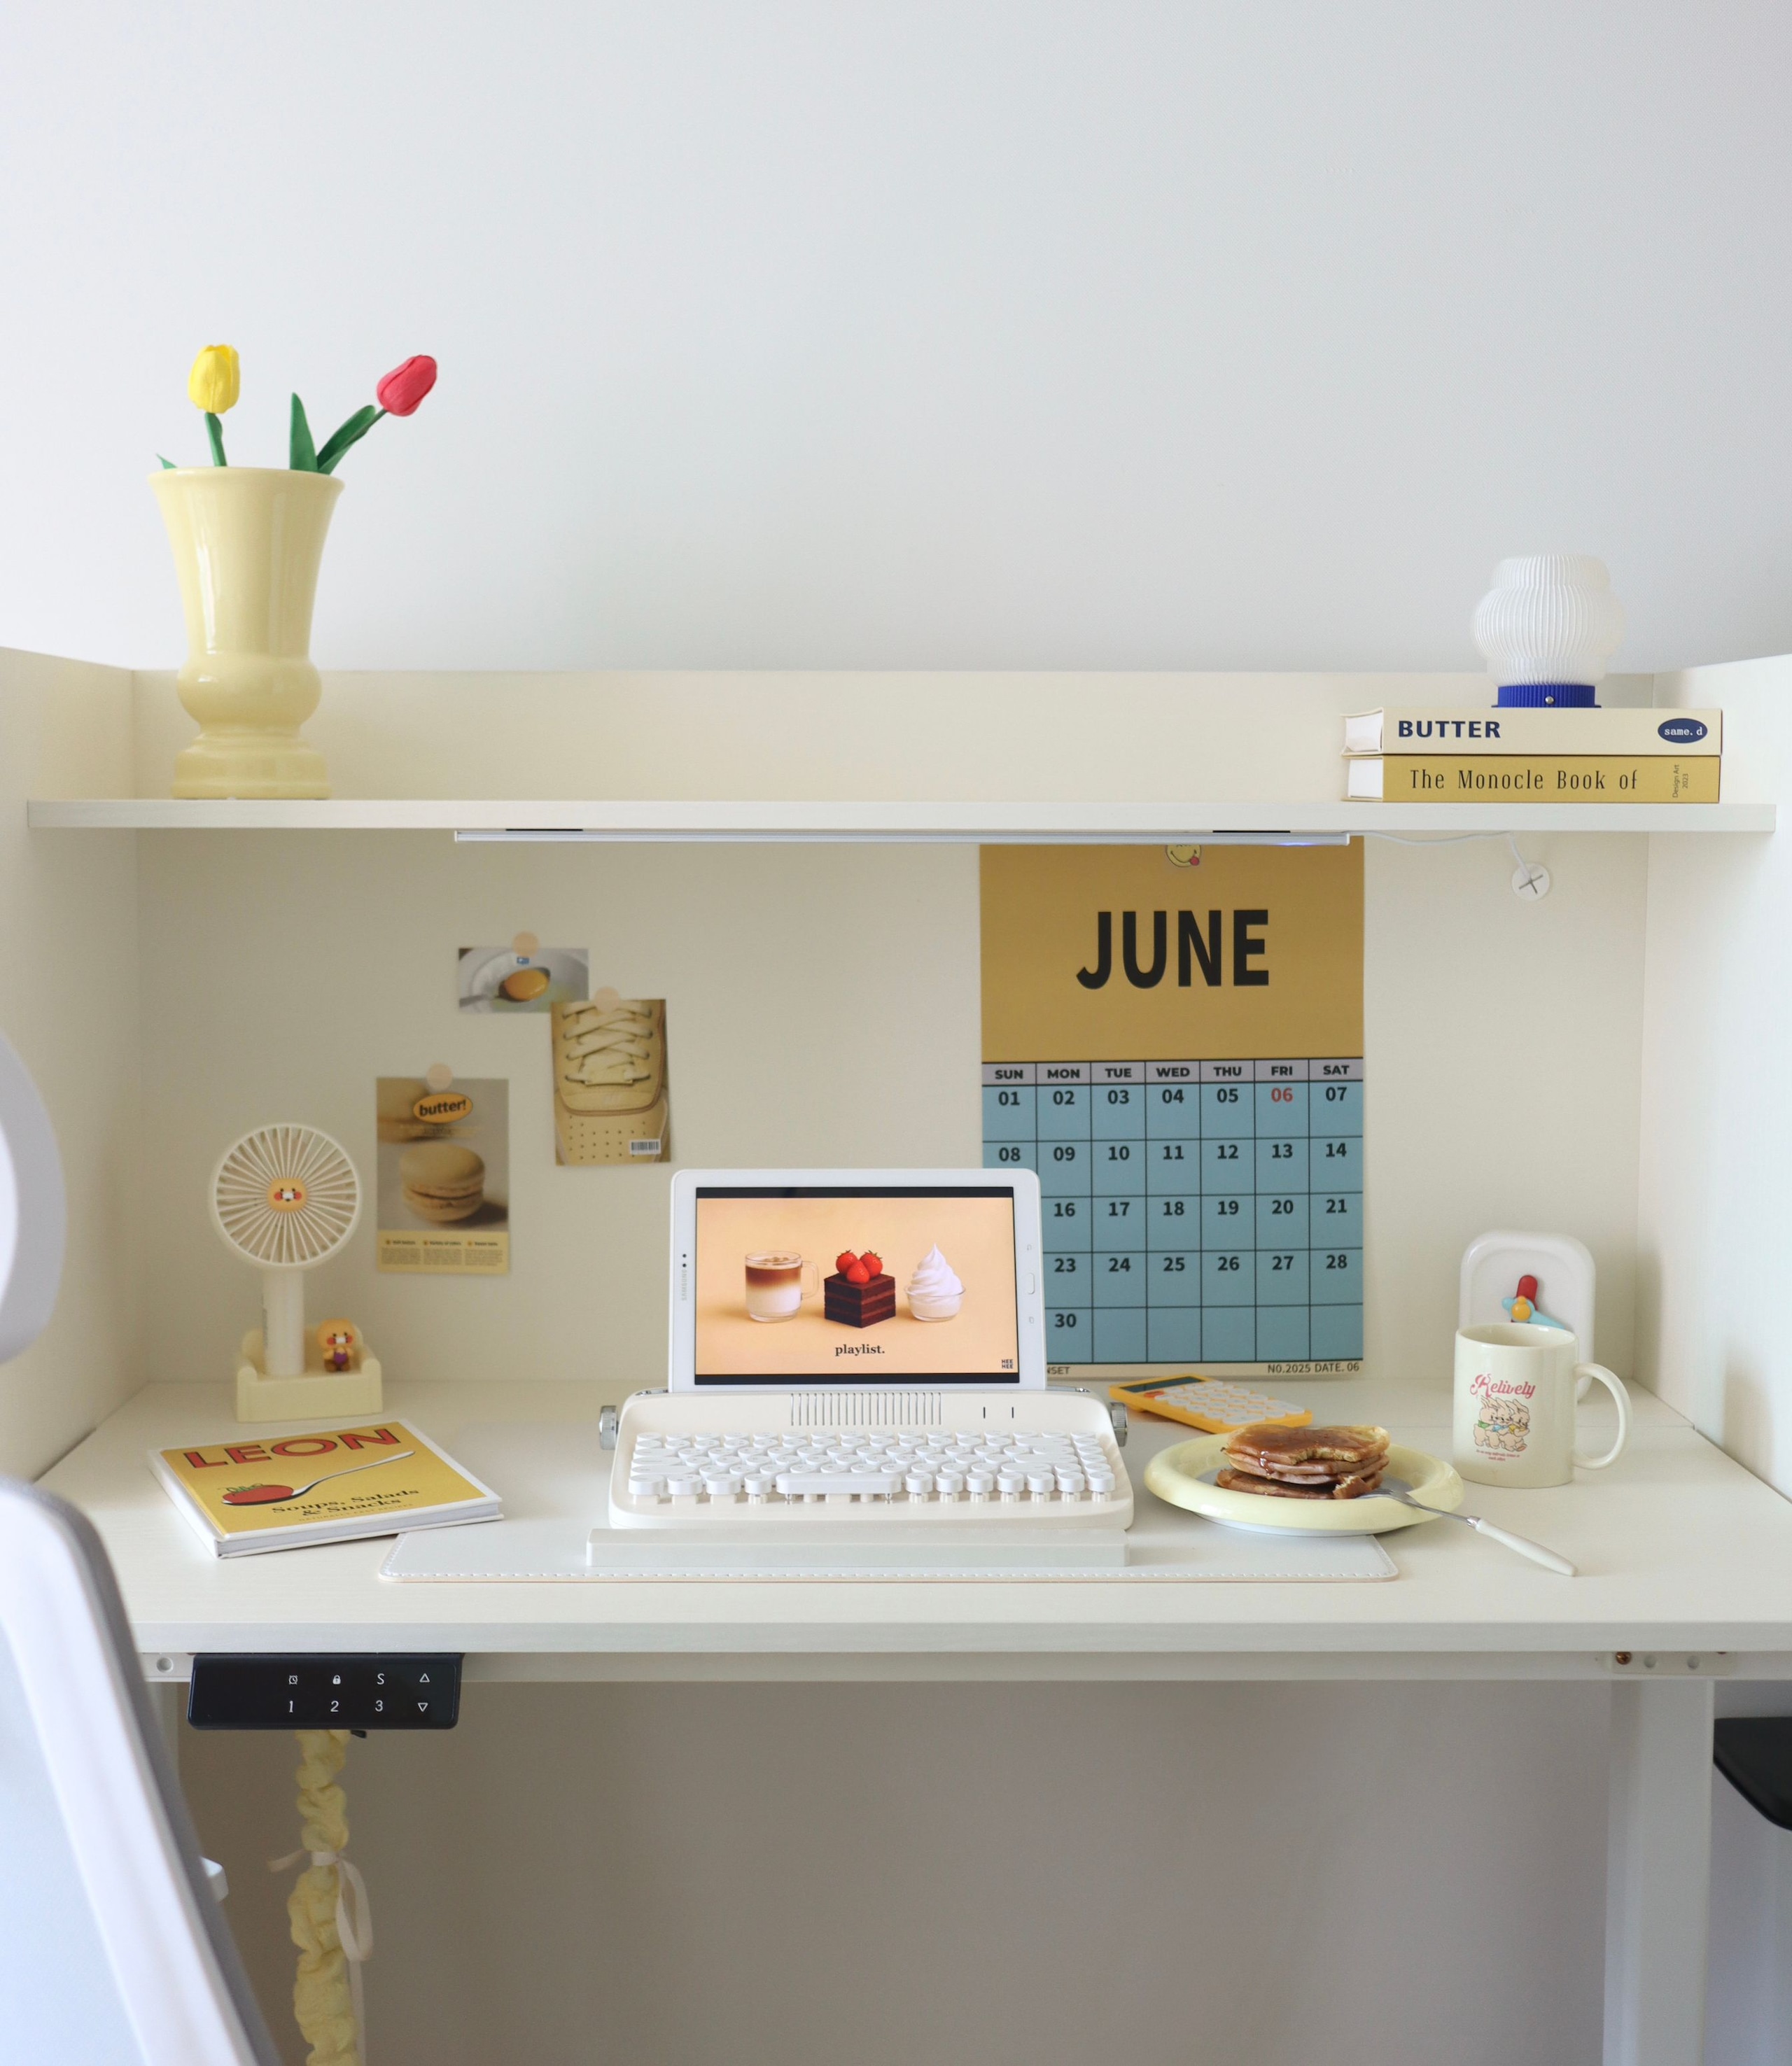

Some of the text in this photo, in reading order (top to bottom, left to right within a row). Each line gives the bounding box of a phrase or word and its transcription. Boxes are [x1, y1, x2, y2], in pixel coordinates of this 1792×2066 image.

[1398, 720, 1501, 738] BUTTER
[1696, 726, 1703, 736] d
[1410, 768, 1637, 789] The Monocle Book of
[1672, 775, 1681, 798] Design
[1076, 908, 1269, 990] JUNE
[995, 1064, 1350, 1080] SUN MON TUE WED THU FRI SAT
[998, 1086, 1348, 1106] 01 02 03 04 05 06 07
[420, 1099, 467, 1117] butter!
[998, 1142, 1348, 1162] 08 09 10 11 12 13 14
[1054, 1198, 1348, 1217] 16 17 18 19 20 21
[1054, 1253, 1348, 1273] 23 24 25 26 27 28
[1054, 1313, 1077, 1328] 30
[835, 1344, 885, 1357] playlist.
[1315, 1363, 1345, 1372] DATE.
[1347, 1362, 1360, 1372] 06
[1469, 1373, 1536, 1399] Relively
[183, 1428, 401, 1468] LEON
[272, 1489, 419, 1513] Soups, Salads
[327, 1498, 401, 1512] Snacks
[377, 1673, 385, 1685] S
[288, 1699, 384, 1713] 1 2 3
